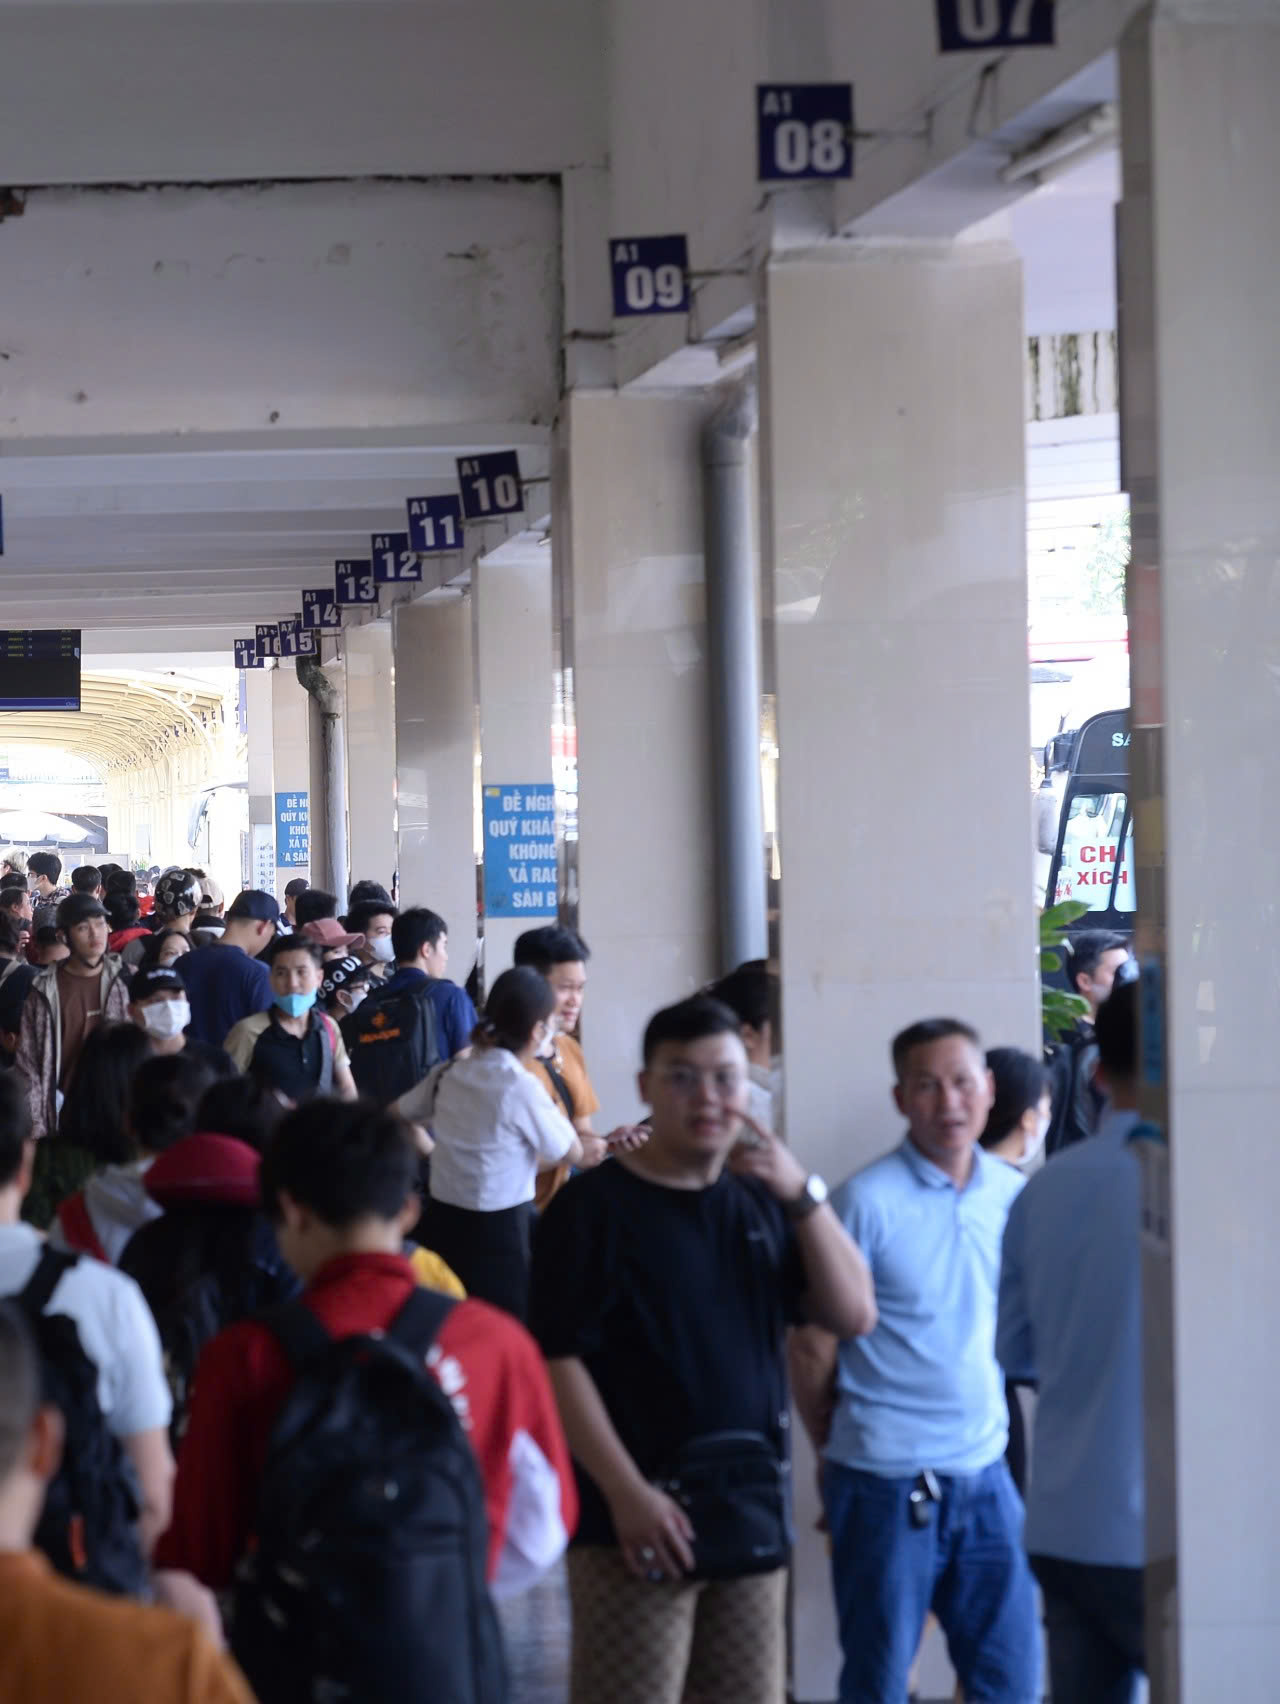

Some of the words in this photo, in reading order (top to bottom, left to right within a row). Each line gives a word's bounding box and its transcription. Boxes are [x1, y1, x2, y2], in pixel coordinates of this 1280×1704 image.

[763, 92, 792, 115] A1
[774, 120, 845, 173] 08
[614, 244, 638, 263] A1
[625, 264, 683, 310] 09
[461, 460, 480, 476] A1
[472, 474, 518, 512] 10
[411, 501, 428, 515] A1
[419, 515, 456, 547] 11
[375, 537, 390, 549] A1
[338, 563, 352, 574] A1
[382, 551, 418, 578] 12
[304, 592, 317, 602] A1
[344, 576, 376, 600] 13
[310, 603, 338, 625] 14
[257, 627, 268, 635] A1
[286, 631, 313, 652] 15
